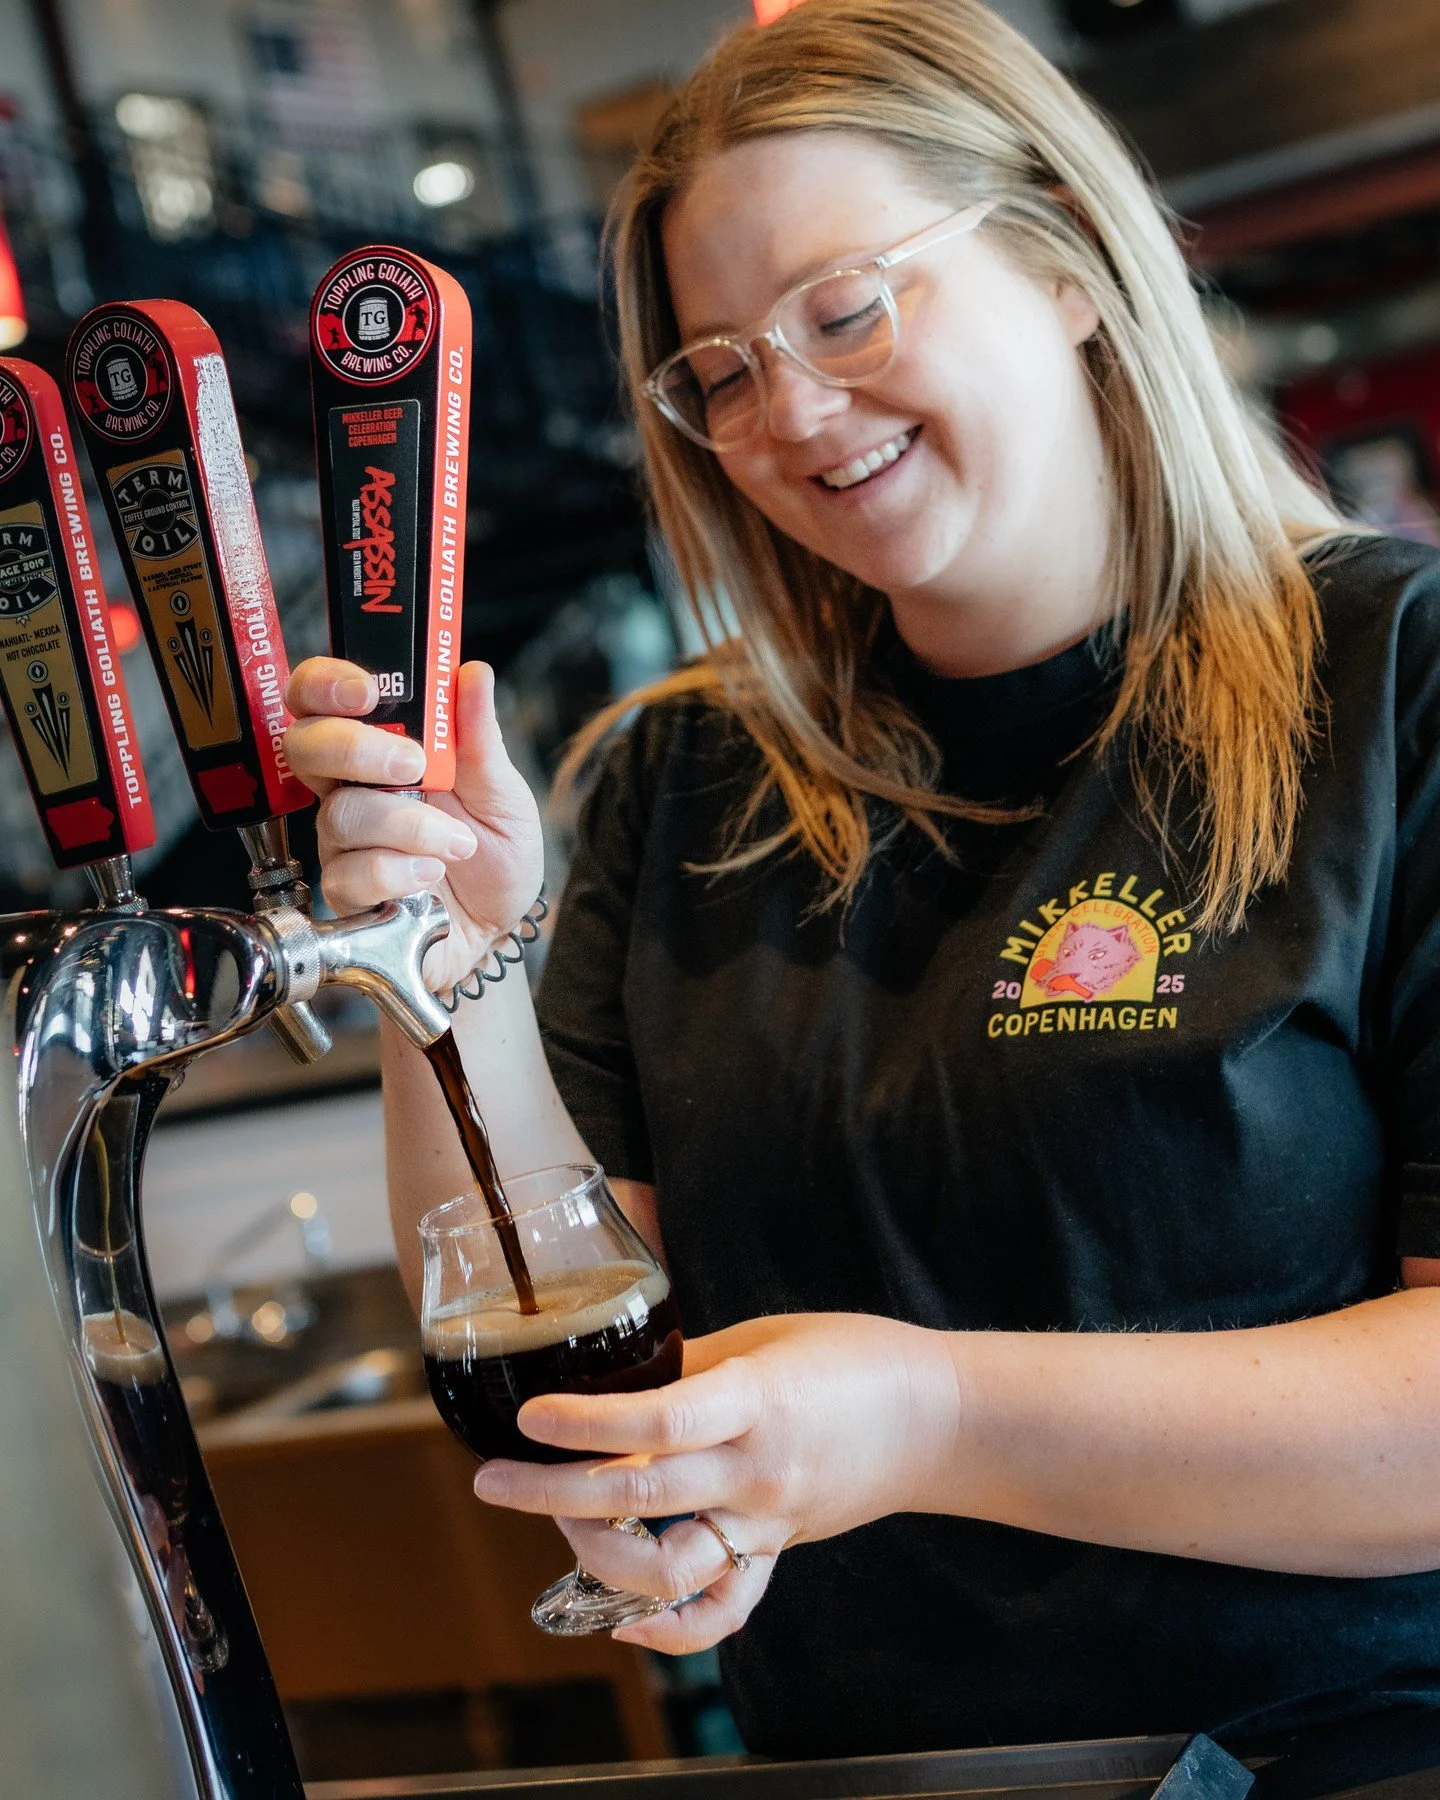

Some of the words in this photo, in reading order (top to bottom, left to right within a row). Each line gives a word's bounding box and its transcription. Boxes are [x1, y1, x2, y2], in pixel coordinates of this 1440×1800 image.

[324, 263, 375, 310] TOPPLING
[378, 263, 424, 300] GOLIATH
[361, 311, 387, 326] TG
[77, 324, 111, 376] TOPPLING
[113, 322, 156, 354] GOLIATH
[341, 351, 392, 373] BREWING
[392, 345, 413, 363] CO.
[448, 345, 464, 385] CO.
[111, 367, 132, 385] TG
[105, 411, 148, 432] BREWING
[145, 400, 162, 418] CO.
[348, 420, 397, 435] CELEBRATION
[384, 408, 403, 419] BEER
[50, 426, 67, 464] CO.
[348, 432, 397, 447] COPENHAGEN
[444, 391, 462, 509] BREWING
[118, 470, 183, 503] TERM
[58, 471, 94, 580] BREWING
[124, 510, 144, 523] COFFEE
[144, 506, 166, 518] GROUND
[165, 499, 189, 513] CONTROL
[141, 527, 191, 553] OIL
[343, 466, 403, 613] ASSASSIN
[22, 558, 44, 572] 2019
[439, 516, 457, 622] GOLIATH
[34, 624, 61, 638] MEXICA
[84, 589, 116, 686] GOLIATH
[6, 648, 20, 662] HOT
[21, 639, 61, 658] CHOCOLATE
[434, 629, 453, 752] TOPPLING
[107, 693, 142, 809] TOPPLING
[999, 872, 1192, 965] MIKKELLER
[1070, 903, 1158, 954] CELEBRATION
[991, 980, 1022, 1000] 20
[1156, 974, 1186, 994] 25
[987, 1006, 1178, 1039] COPENHAGEN
